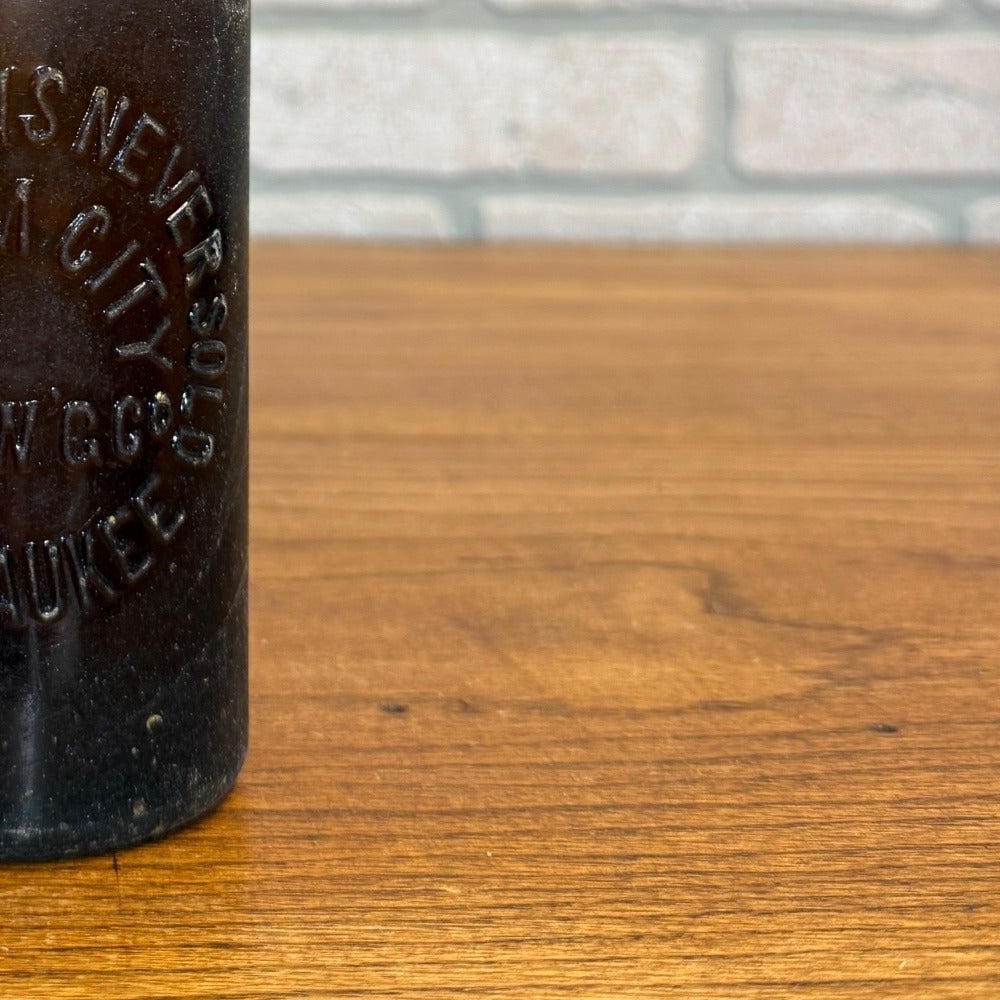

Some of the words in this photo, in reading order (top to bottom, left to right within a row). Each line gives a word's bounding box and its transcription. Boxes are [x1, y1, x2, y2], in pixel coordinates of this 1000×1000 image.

[60, 205, 174, 370] CITY
[72, 86, 224, 287] NEVER
[173, 293, 228, 466] SOLD
